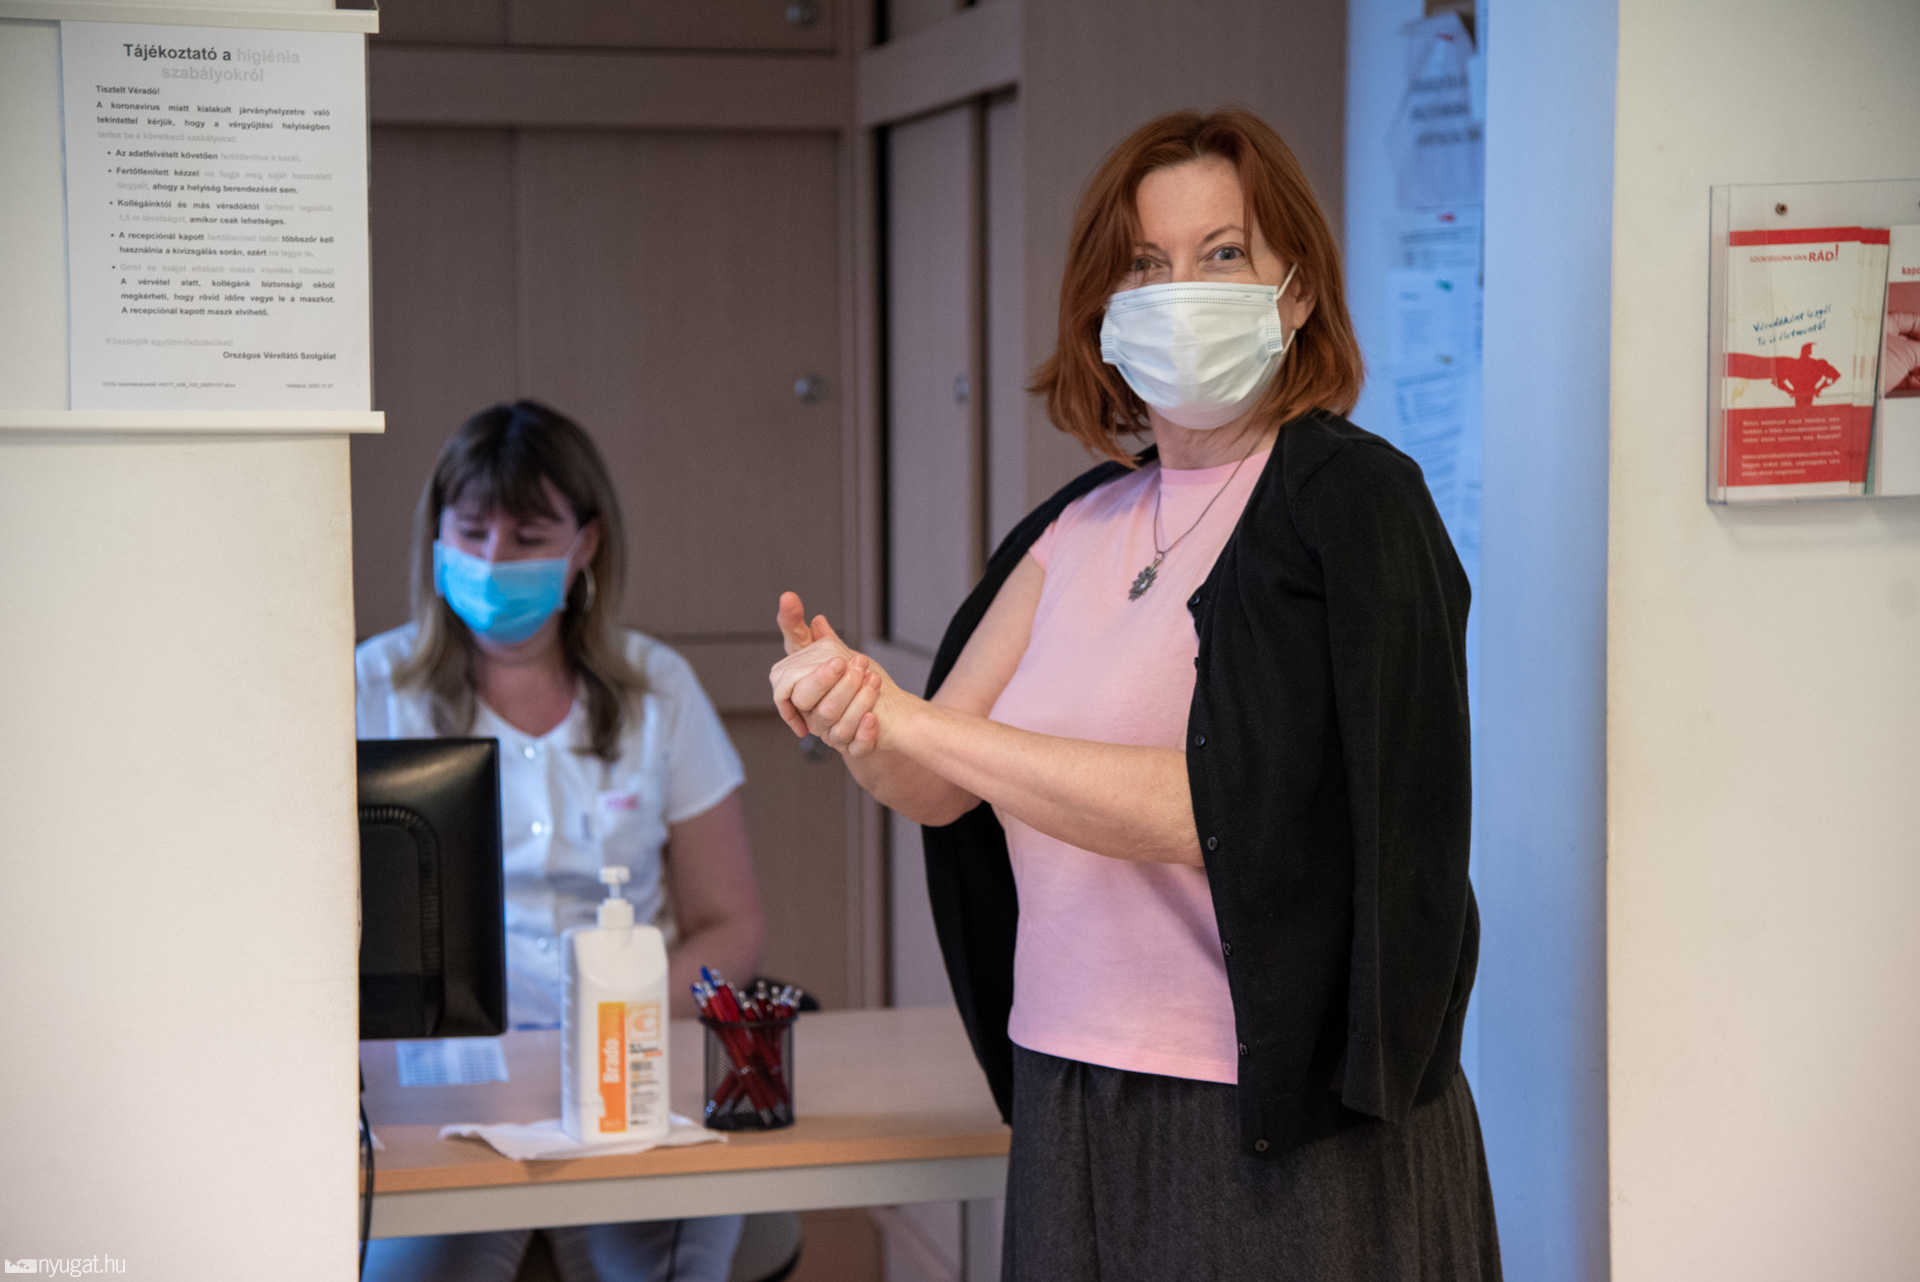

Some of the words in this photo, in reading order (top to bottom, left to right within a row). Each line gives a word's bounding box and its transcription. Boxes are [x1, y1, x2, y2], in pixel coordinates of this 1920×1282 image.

[123, 44, 217, 61] Tájékoztató
[222, 51, 231, 61] a
[96, 85, 126, 94] Tisztelt
[197, 105, 231, 113] kialakult
[185, 120, 205, 128] hogy
[115, 149, 126, 157] Az
[174, 169, 199, 177] kézzel
[152, 183, 178, 192] ahogy
[190, 216, 218, 224] amikor
[241, 217, 286, 226] lehetséges.
[119, 231, 125, 239] A
[178, 233, 204, 242] kapott
[1809, 244, 1839, 262] RÁD!
[174, 294, 194, 303] hogy
[121, 307, 128, 315] A
[179, 308, 205, 317] kapott
